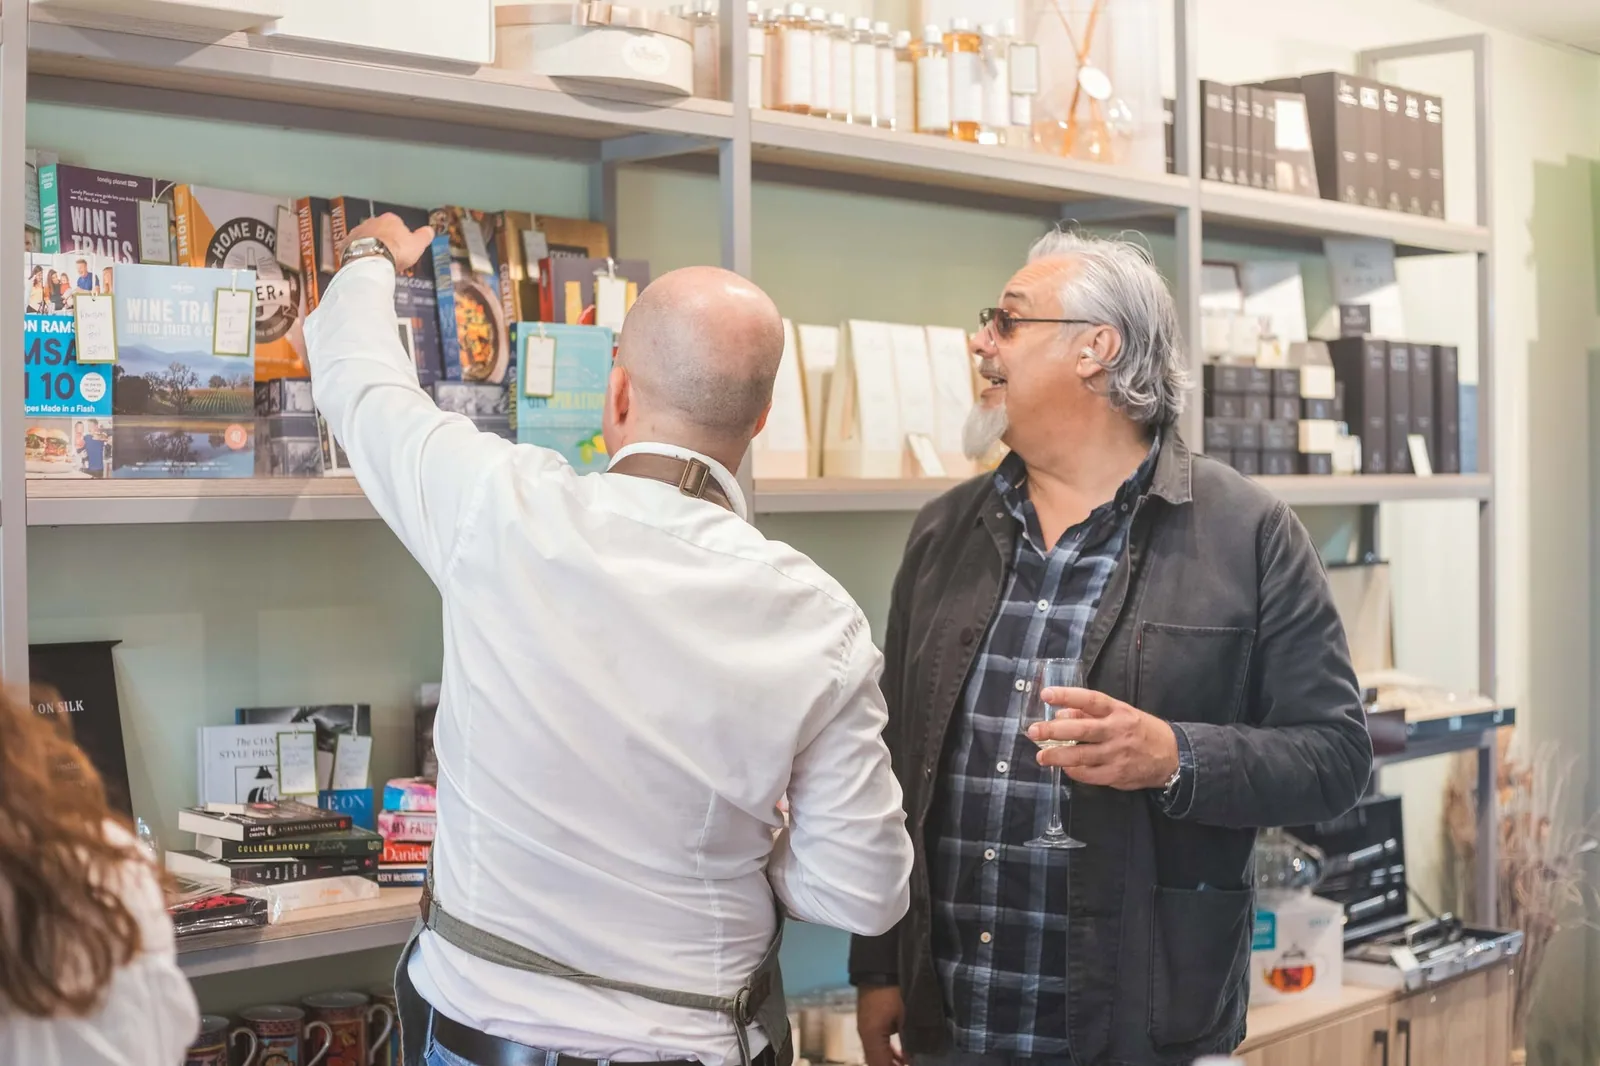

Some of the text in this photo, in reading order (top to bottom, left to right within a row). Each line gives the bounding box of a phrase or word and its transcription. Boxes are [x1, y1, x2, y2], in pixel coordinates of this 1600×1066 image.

[43, 203, 58, 248] WINE
[70, 205, 117, 237] WINE
[176, 214, 188, 256] HOME
[212, 222, 250, 259] HOME
[299, 206, 313, 257] WHISKY
[127, 298, 173, 321] WINE
[128, 322, 160, 334] UNITED
[163, 324, 191, 336] STATES
[41, 372, 75, 399] 10
[41, 404, 61, 412] Made
[62, 404, 69, 412] in
[76, 404, 95, 412] Flash
[37, 700, 84, 714] ON SILK
[236, 736, 251, 746] The
[219, 749, 247, 759] STYLE
[392, 822, 405, 834] MY
[238, 843, 310, 853] COLLEEN HOOVER
